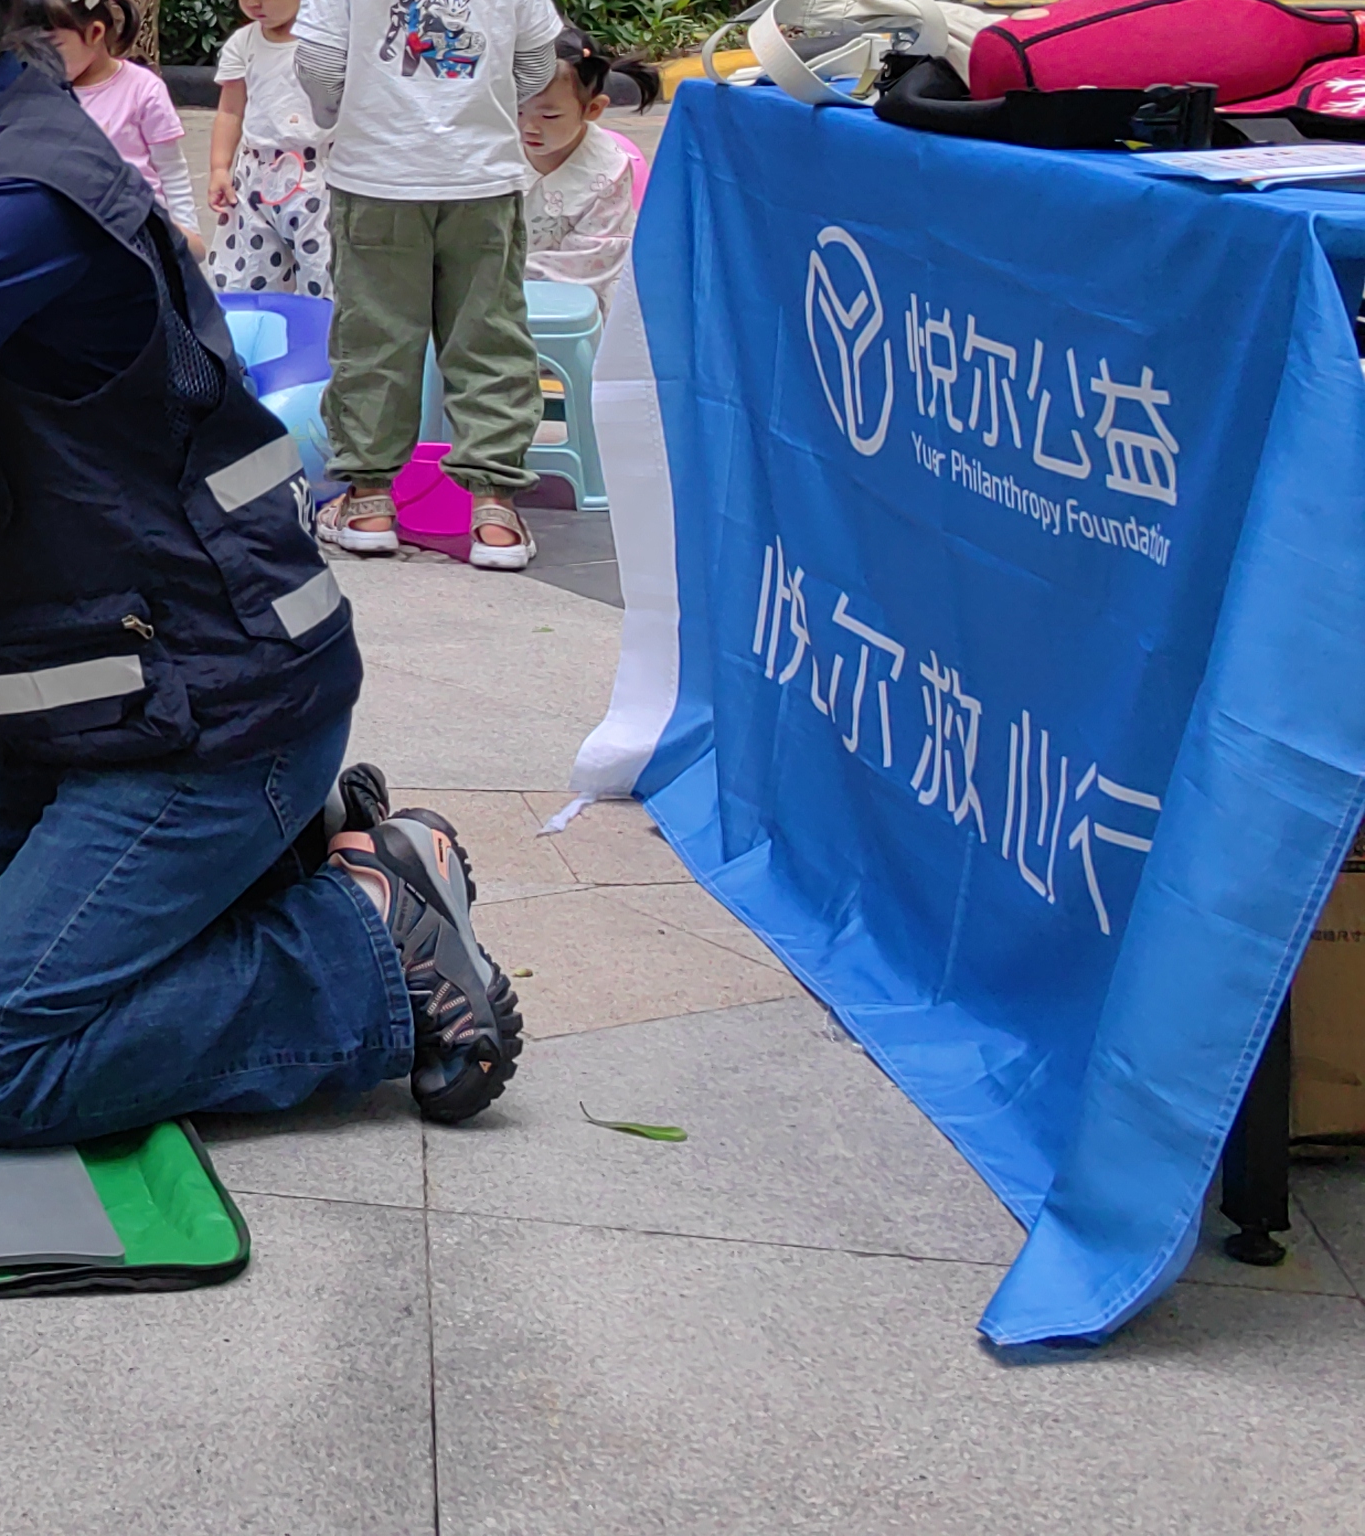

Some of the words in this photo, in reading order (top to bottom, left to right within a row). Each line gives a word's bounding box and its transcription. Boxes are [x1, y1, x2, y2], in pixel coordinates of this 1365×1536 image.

[905, 292, 1179, 506] 悦尔公益
[951, 448, 1061, 536] Philanthropy
